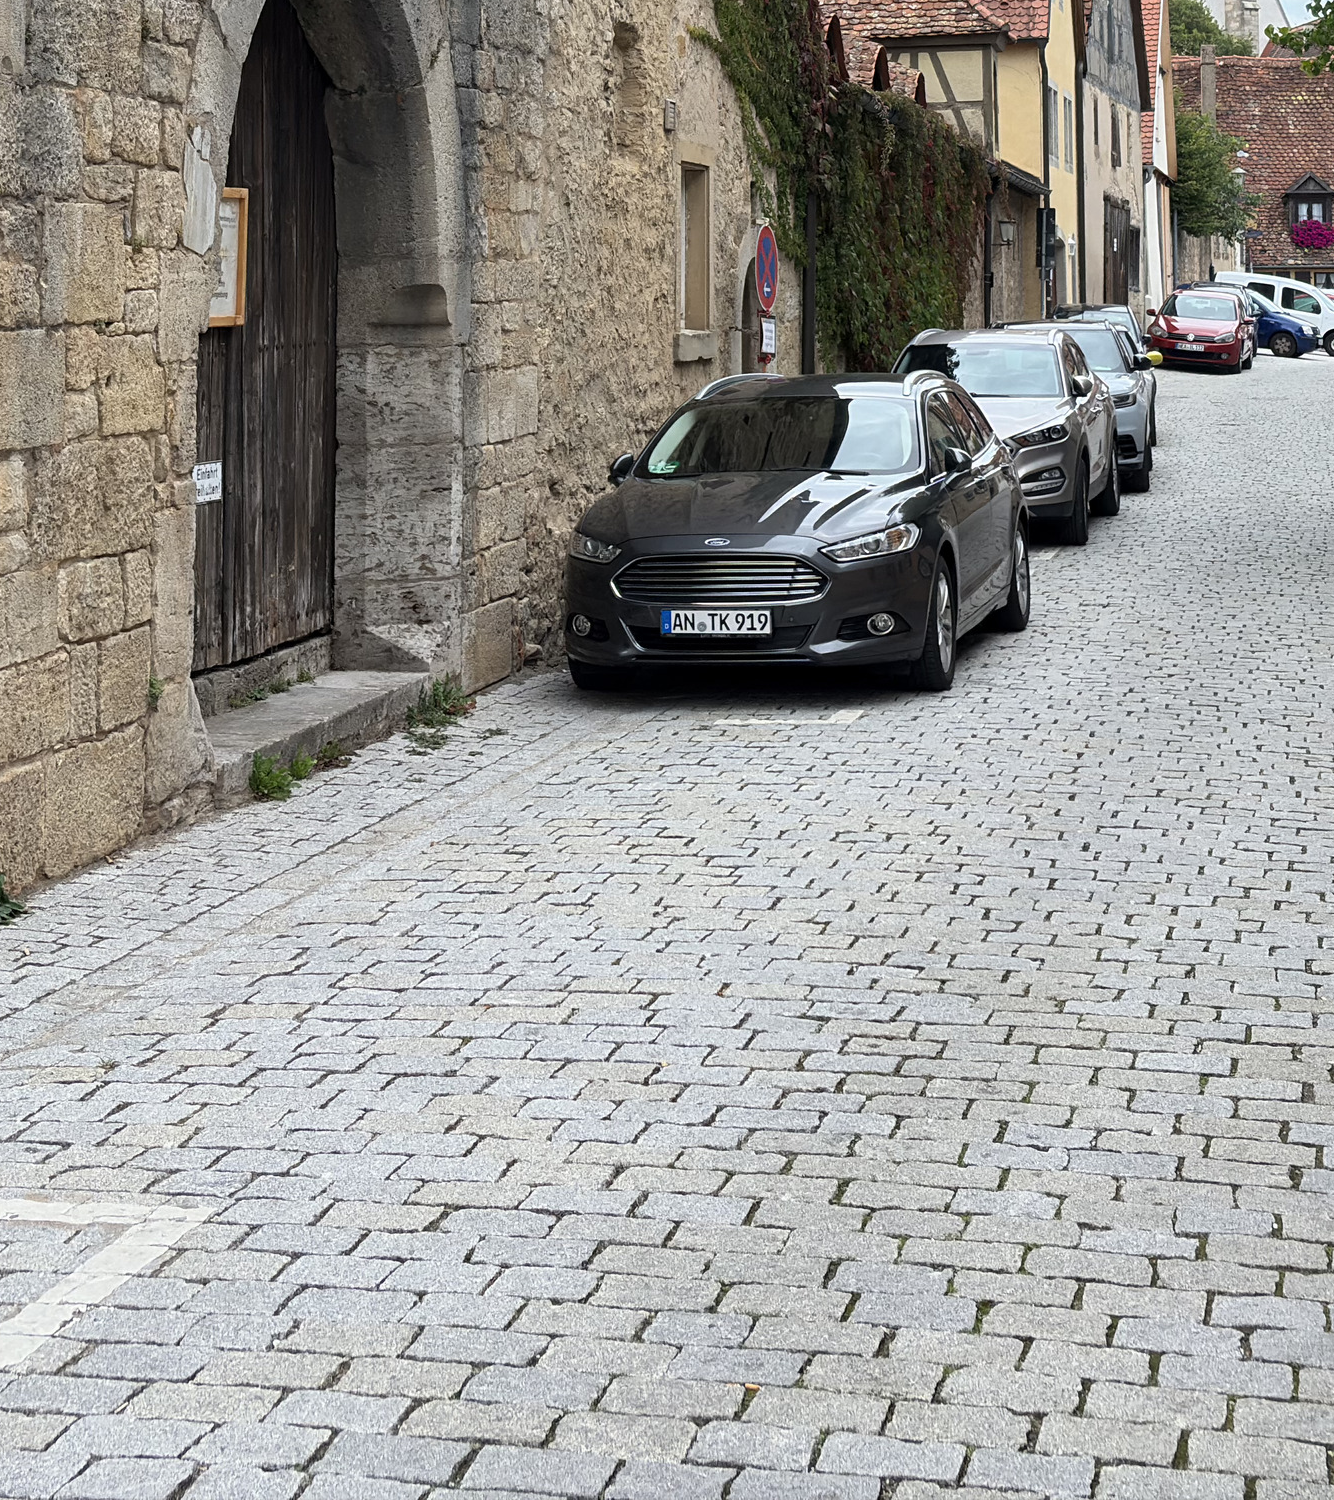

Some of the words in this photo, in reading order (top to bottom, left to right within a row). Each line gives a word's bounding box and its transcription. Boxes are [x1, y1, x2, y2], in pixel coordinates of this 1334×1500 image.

[672, 613, 696, 631] AN
[707, 613, 731, 631] TK
[735, 613, 768, 631] 919
